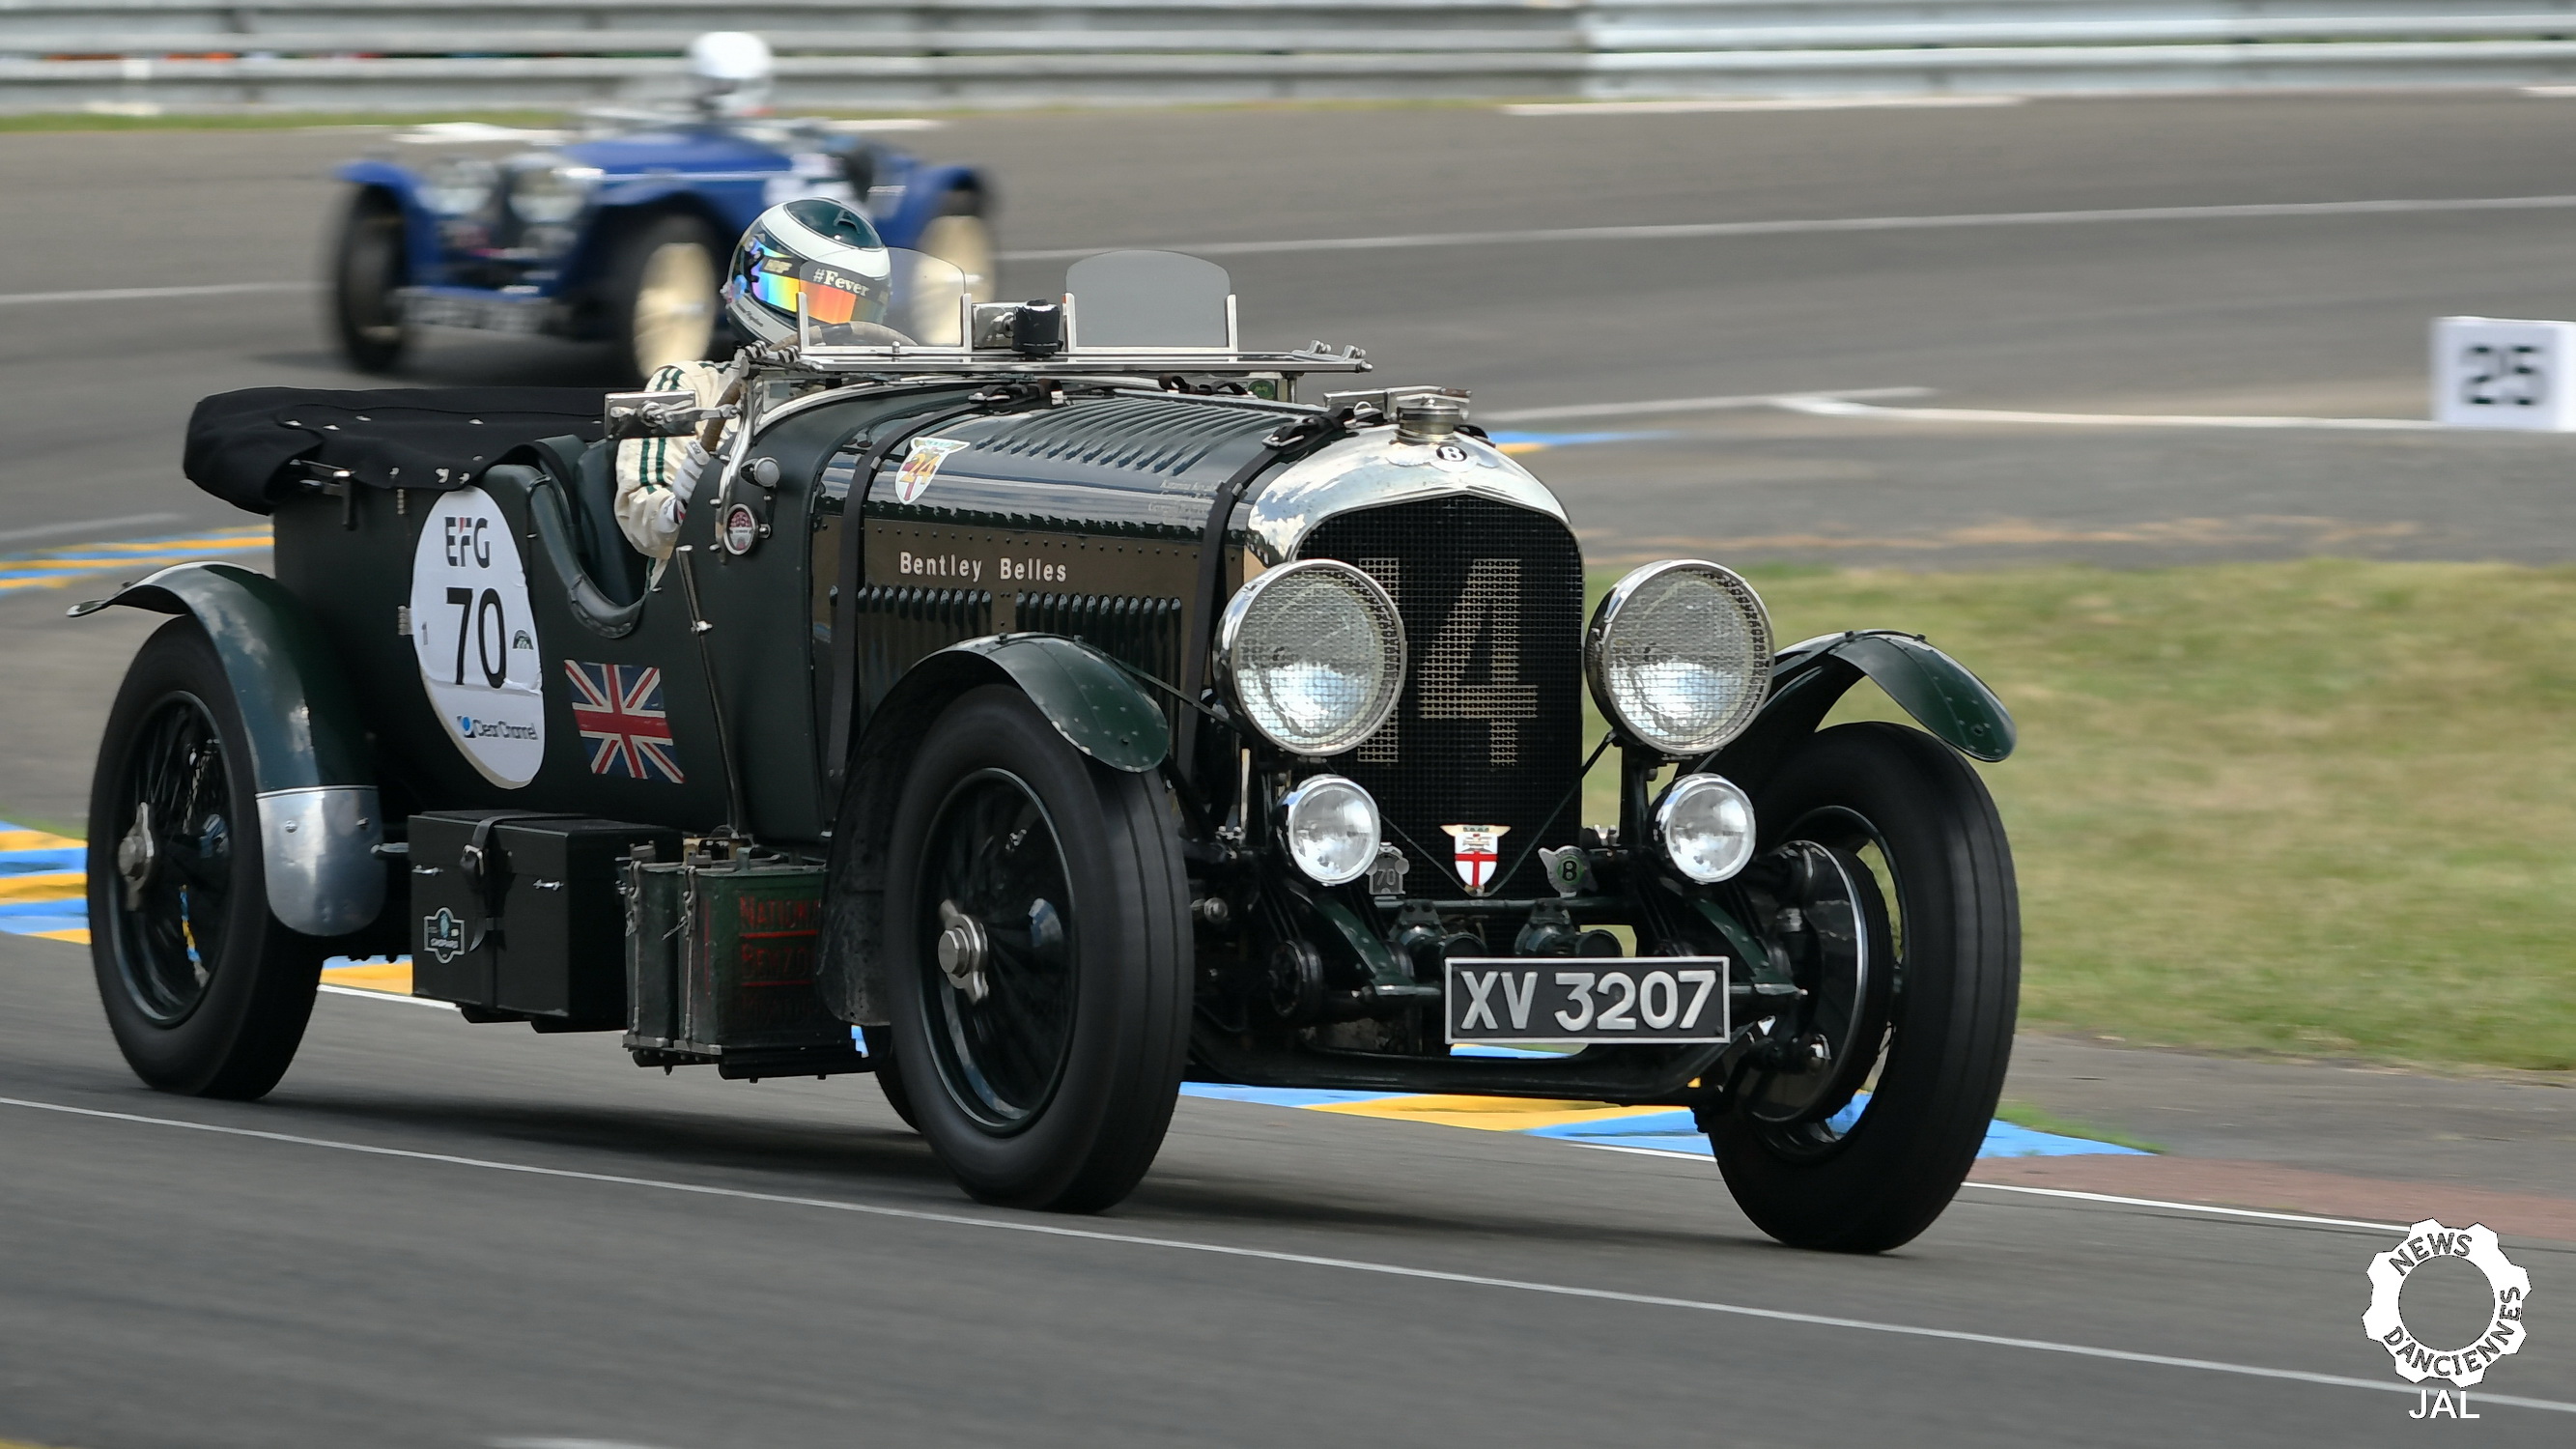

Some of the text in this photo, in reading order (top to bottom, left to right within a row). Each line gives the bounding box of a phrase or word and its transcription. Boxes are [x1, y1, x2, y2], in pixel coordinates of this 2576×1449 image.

[812, 268, 870, 297] #Fever
[2460, 343, 2548, 407] 25
[899, 453, 941, 485] 24
[444, 516, 491, 569] EFG
[899, 551, 1067, 583] Bentley Belles
[445, 586, 508, 690] 70
[1376, 867, 1397, 886] 70
[1459, 968, 1717, 1033] XV 3207
